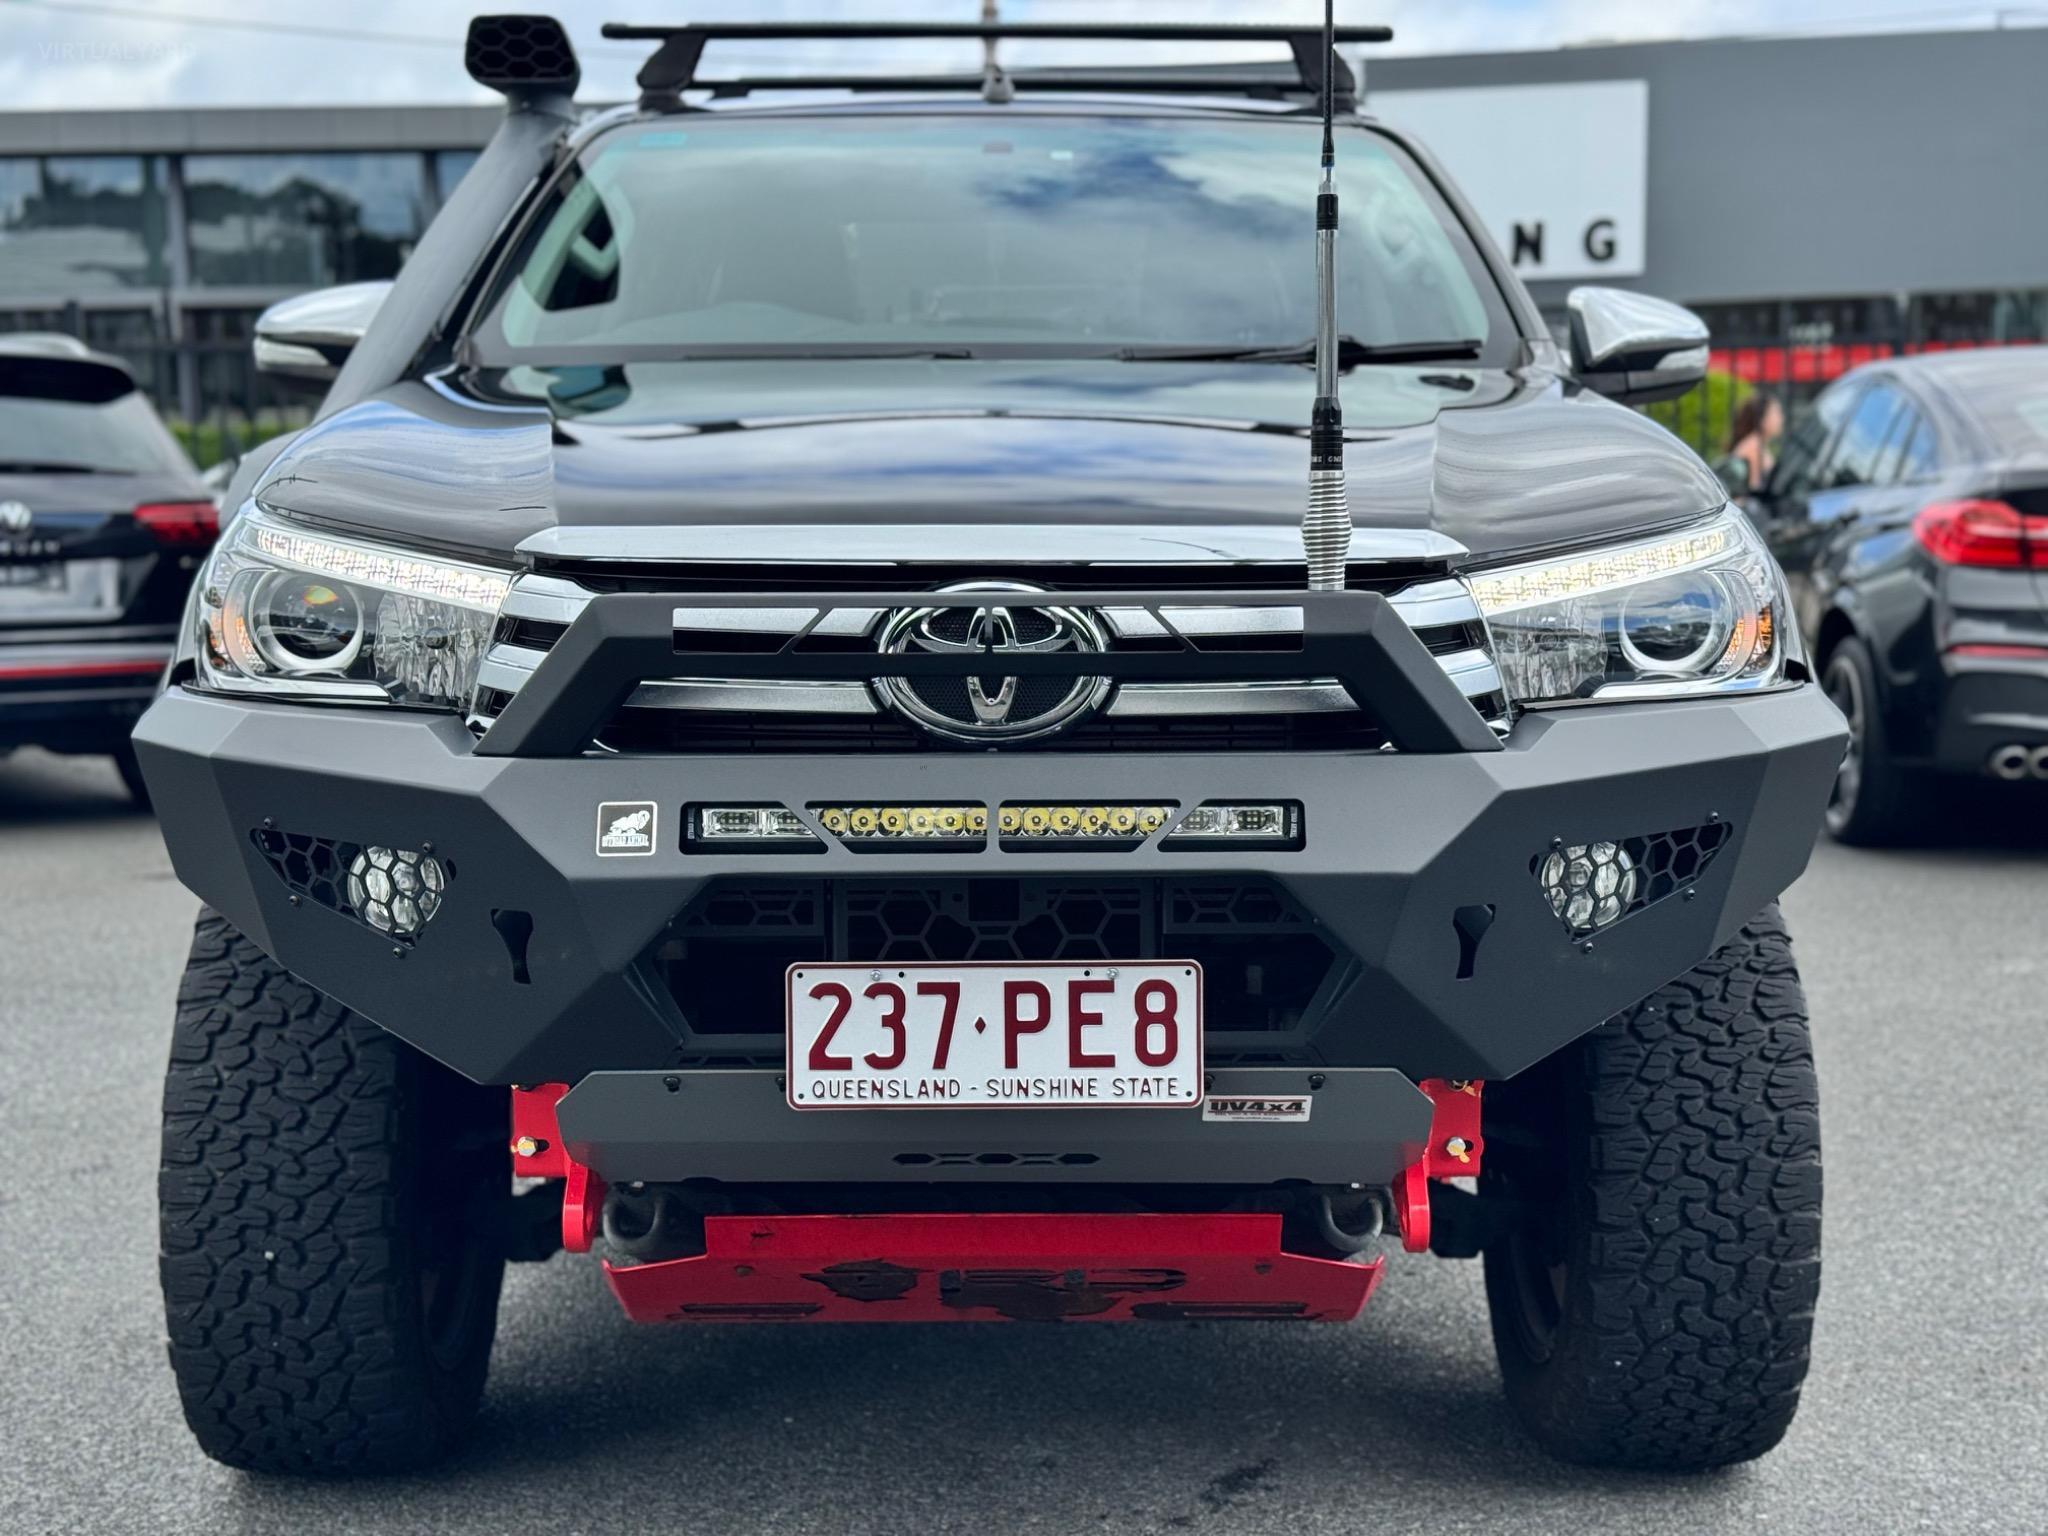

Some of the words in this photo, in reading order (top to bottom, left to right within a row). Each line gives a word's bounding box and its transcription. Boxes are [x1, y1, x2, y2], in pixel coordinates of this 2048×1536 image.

[808, 981, 961, 1071] 237
[1003, 978, 1179, 1069] PE8
[812, 1079, 961, 1099] QUEENSLAND
[986, 1077, 1098, 1098] SUNSHINE
[1112, 1077, 1178, 1097] STATE
